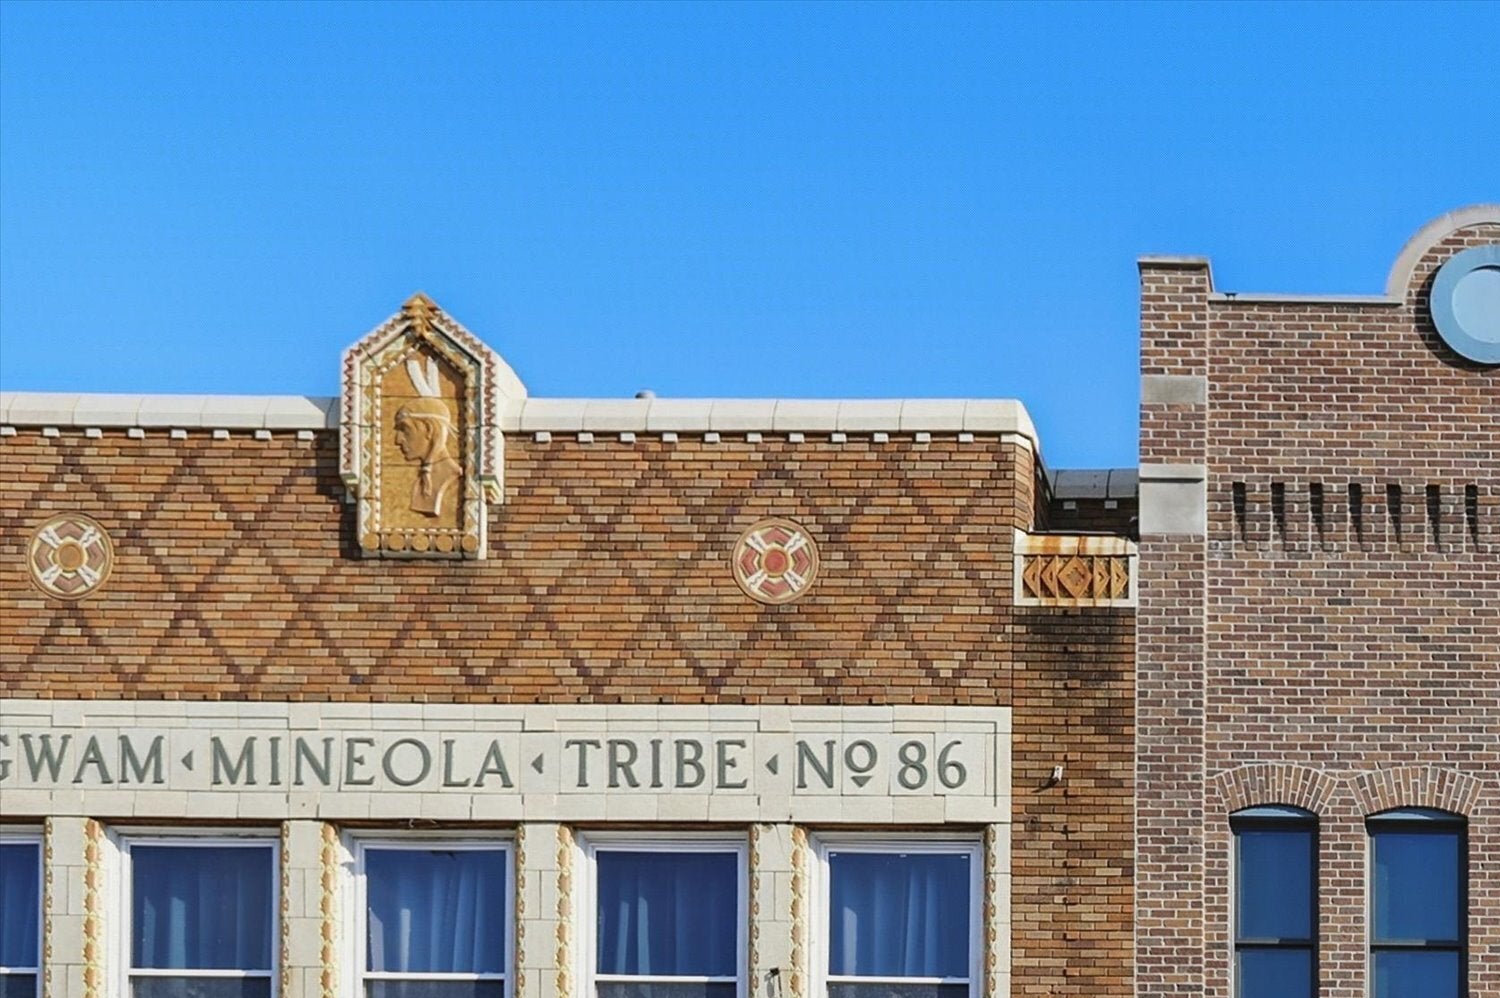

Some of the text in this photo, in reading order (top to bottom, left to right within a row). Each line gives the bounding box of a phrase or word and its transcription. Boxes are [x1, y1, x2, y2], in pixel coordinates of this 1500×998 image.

[210, 736, 515, 789] MINEOLA
[565, 739, 748, 788] TRIBE
[898, 740, 967, 790] 86
